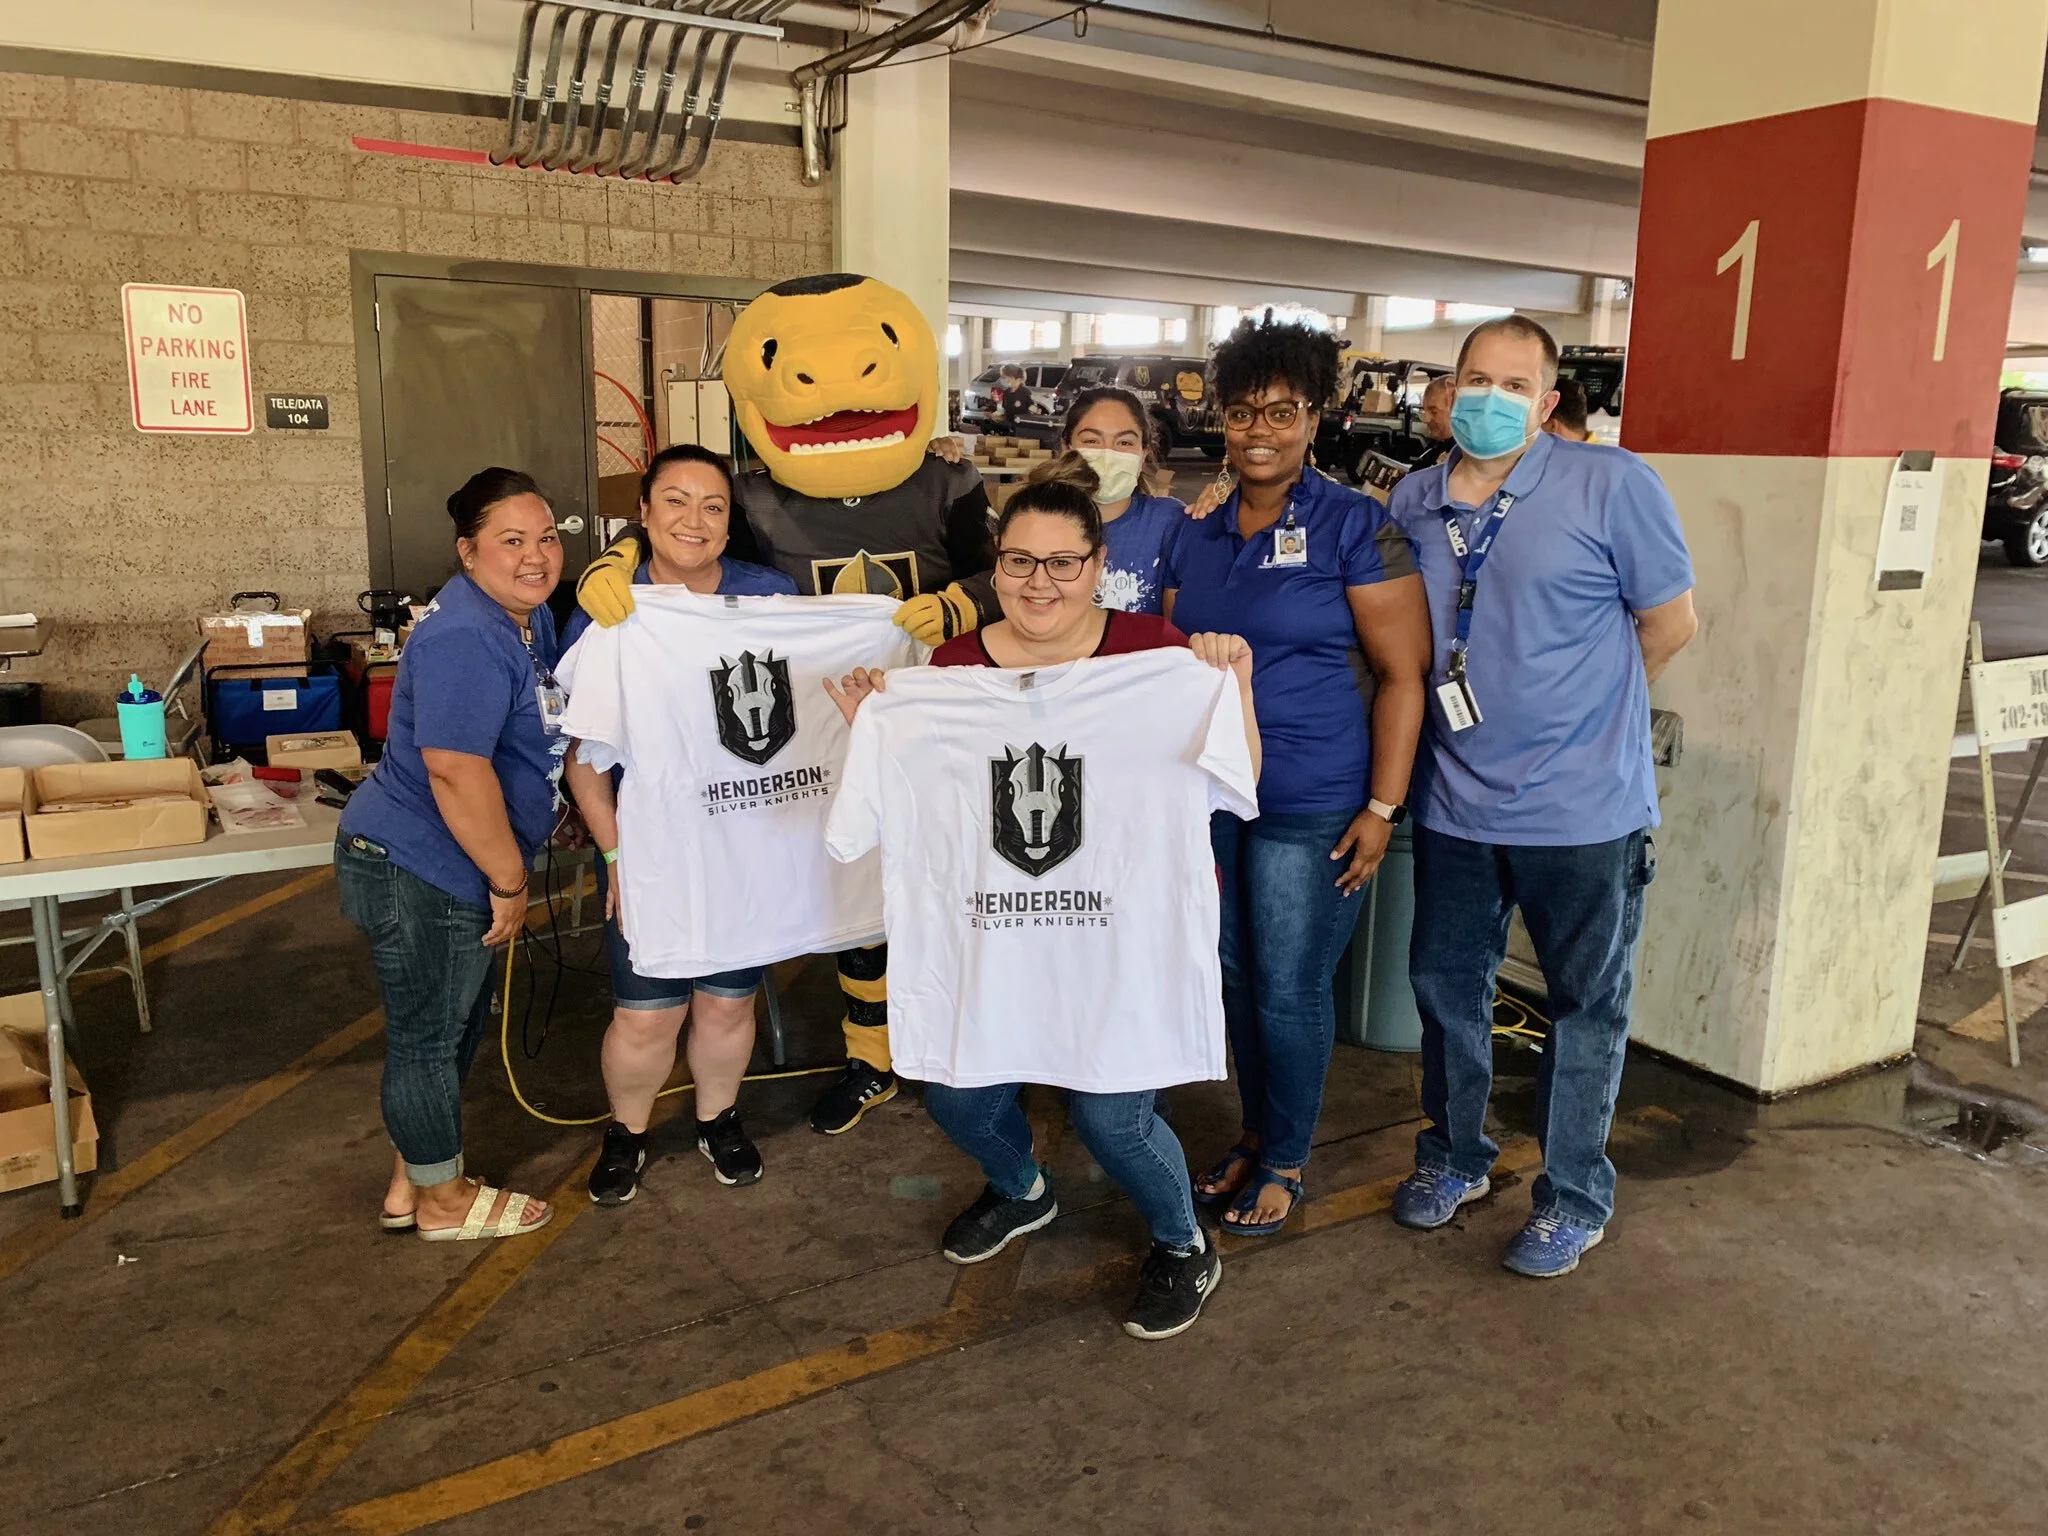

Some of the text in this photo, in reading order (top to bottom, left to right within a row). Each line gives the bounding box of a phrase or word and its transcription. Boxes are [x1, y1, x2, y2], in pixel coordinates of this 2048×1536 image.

[1716, 220, 1760, 360] 1
[1926, 218, 1960, 362] 1
[168, 303, 203, 325] NO
[140, 336, 236, 360] PARKING
[171, 371, 211, 389] FIRE
[171, 399, 218, 416] LANE
[270, 398, 324, 410] TELE/DATA
[288, 413, 310, 425] 104
[1445, 517, 1469, 557] UMC
[708, 766, 823, 802] HENDERSON
[708, 787, 829, 816] SILVER KNIGHTS
[975, 890, 1102, 914] HENDERSON
[971, 917, 1108, 930] SILVER KNIGHTS
